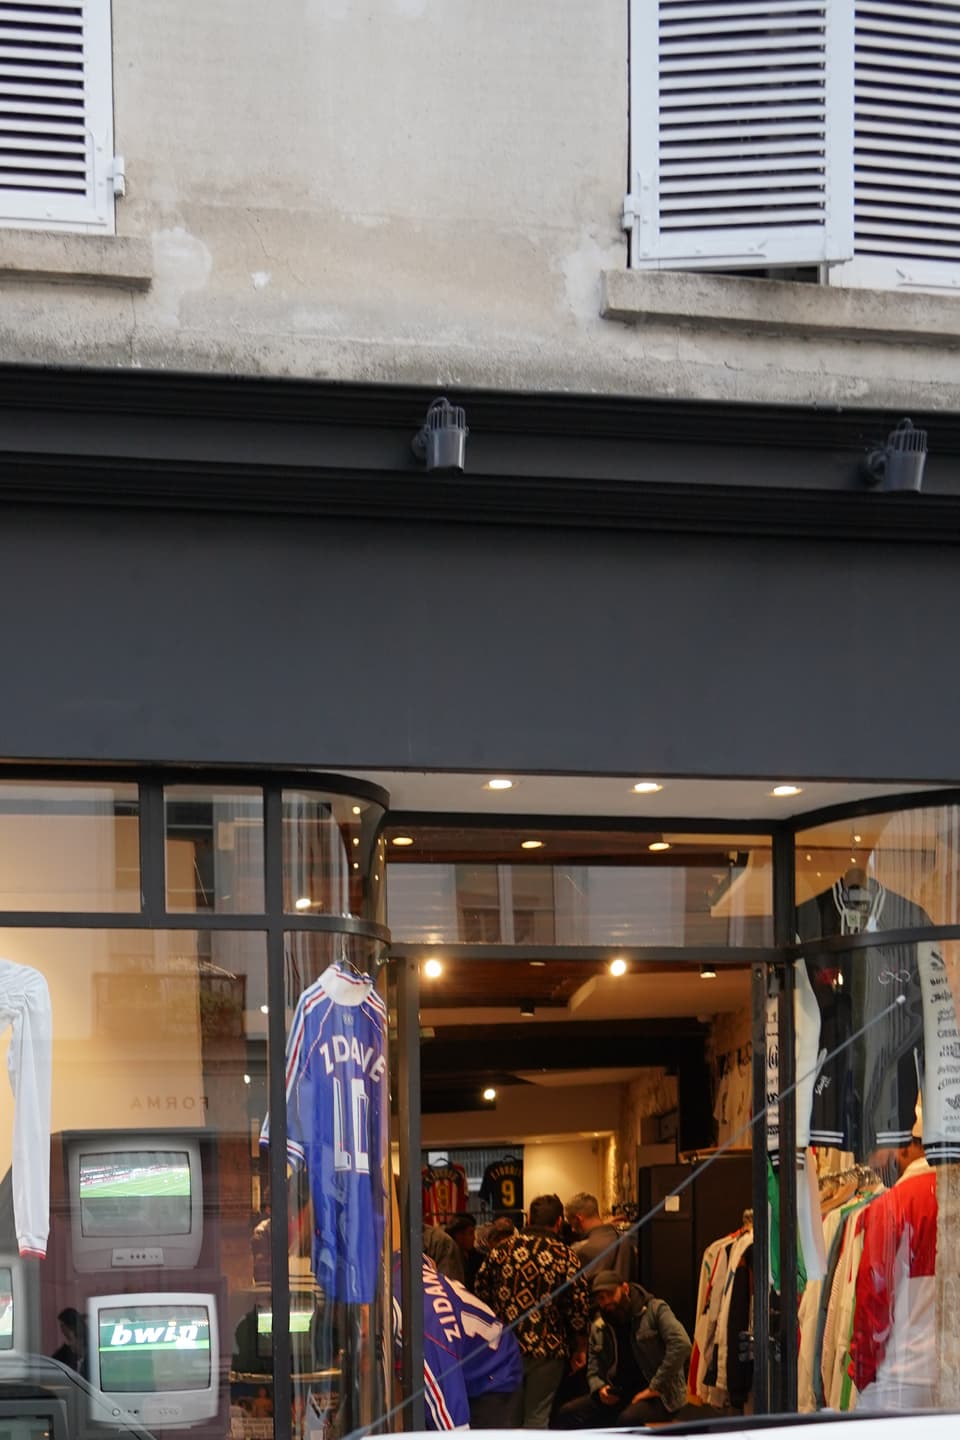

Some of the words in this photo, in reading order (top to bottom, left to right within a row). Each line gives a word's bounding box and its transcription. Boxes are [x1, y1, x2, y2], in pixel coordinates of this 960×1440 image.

[501, 1179, 516, 1207] 9
[422, 1263, 462, 1343] ZIDAN
[111, 1324, 198, 1346] bwin
